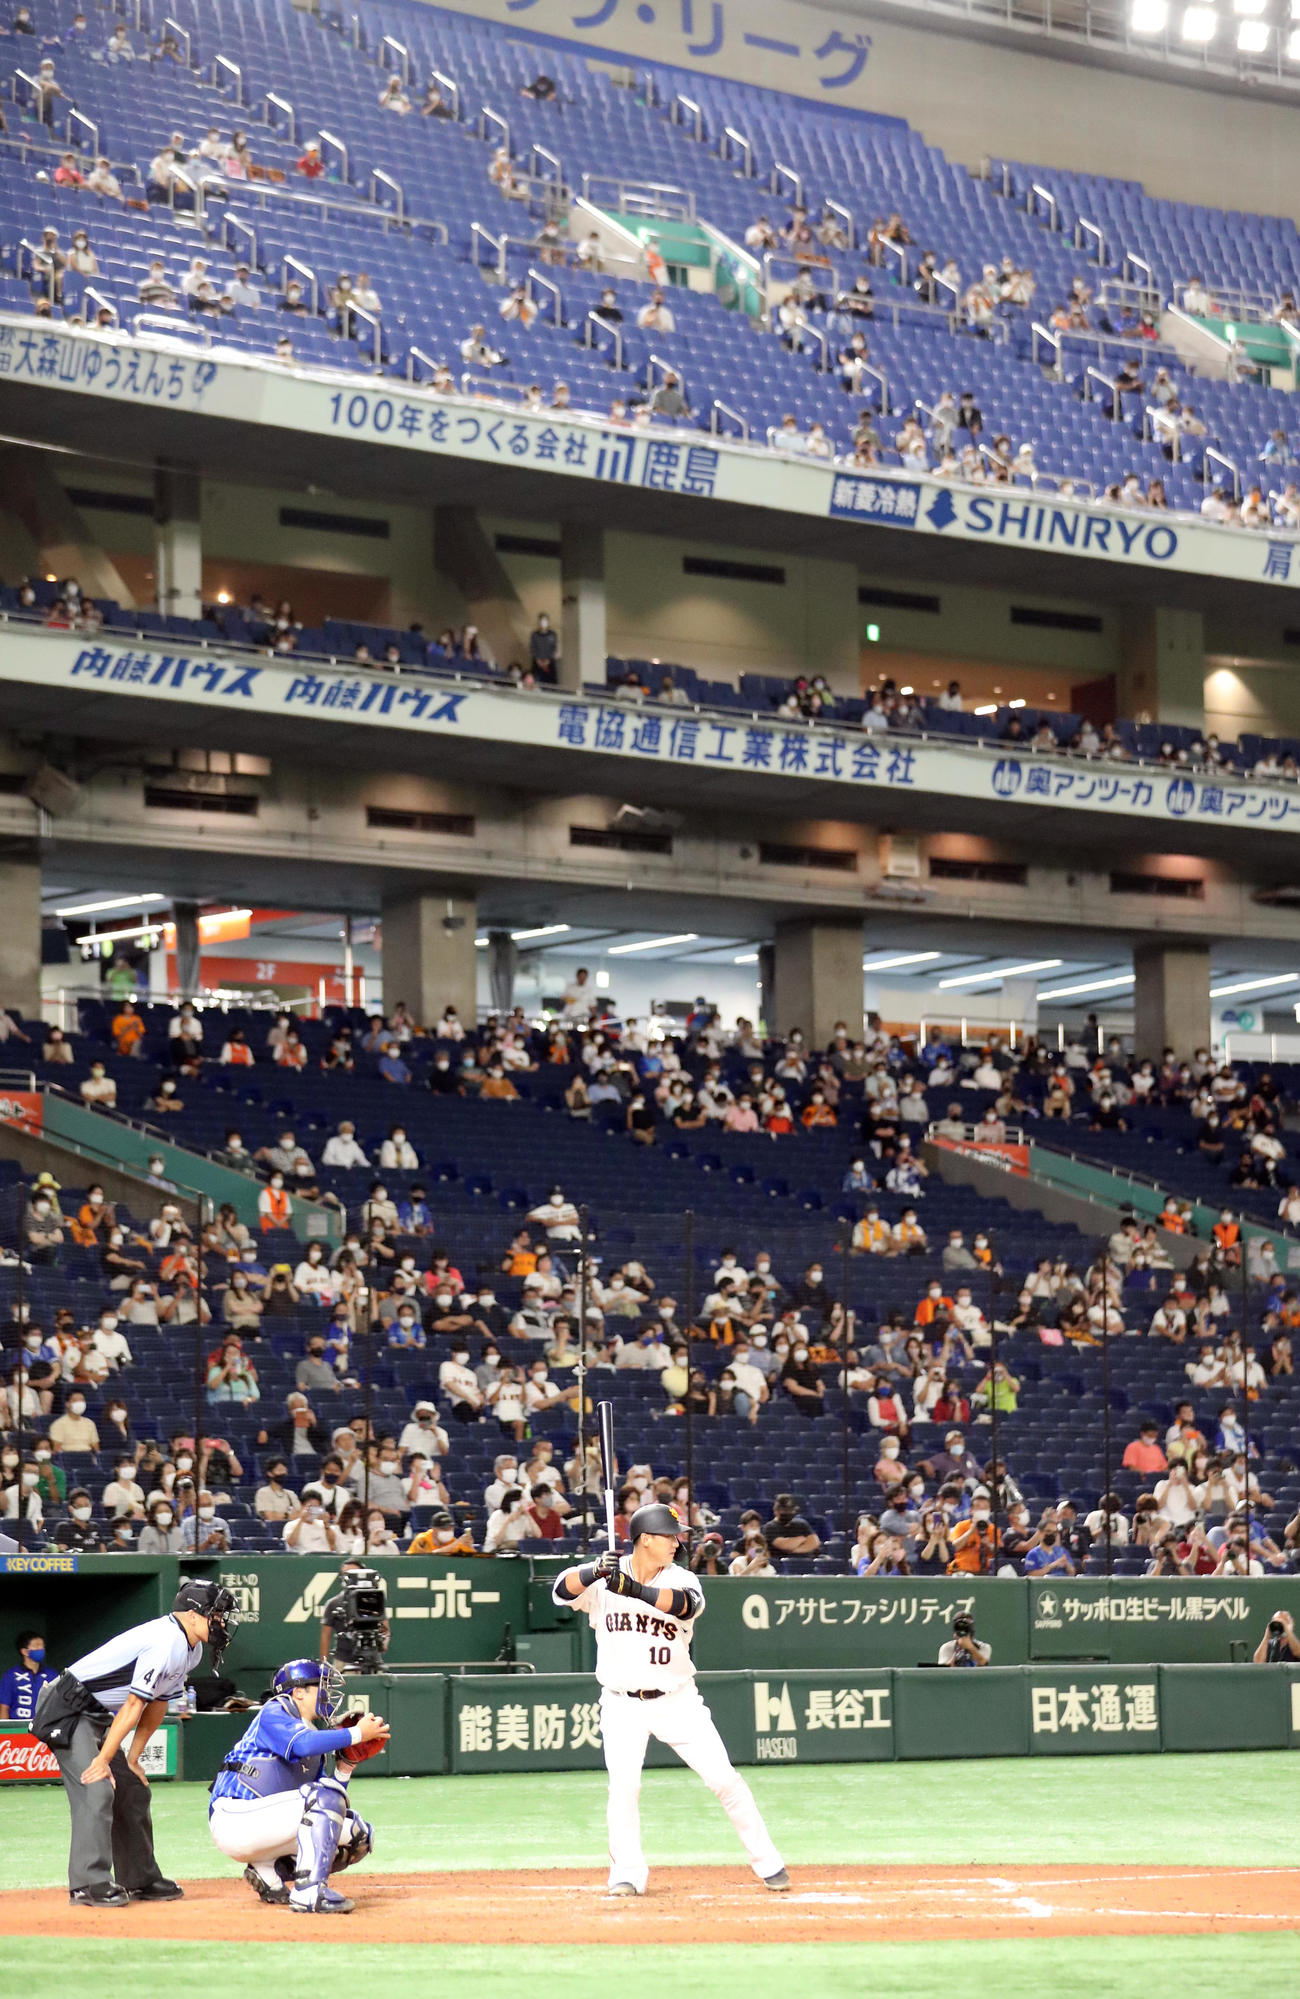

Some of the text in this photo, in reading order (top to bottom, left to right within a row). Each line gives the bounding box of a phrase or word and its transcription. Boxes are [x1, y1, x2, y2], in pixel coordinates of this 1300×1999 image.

[505, 0, 873, 89] ・リーグ
[14, 328, 184, 400] 大森山ゆうえんち
[331, 392, 720, 498] 100年をつくる会社 鹿島
[965, 499, 1178, 560] SHINRYO
[70, 647, 469, 724] 内藤ハウス 内藤ハウス
[557, 704, 917, 785] 電協通信工業株式会社
[605, 1612, 679, 1641] GIANTS
[1062, 1596, 1250, 1622] サッポロ生ビール黒ラベル
[143, 1668, 155, 1686] 4
[649, 1646, 671, 1665] 10
[459, 1702, 603, 1752] 能美防災
[804, 1688, 892, 1730] 長谷工
[1031, 1684, 1159, 1733] 日本通運
[756, 1736, 798, 1759] HASEKO
